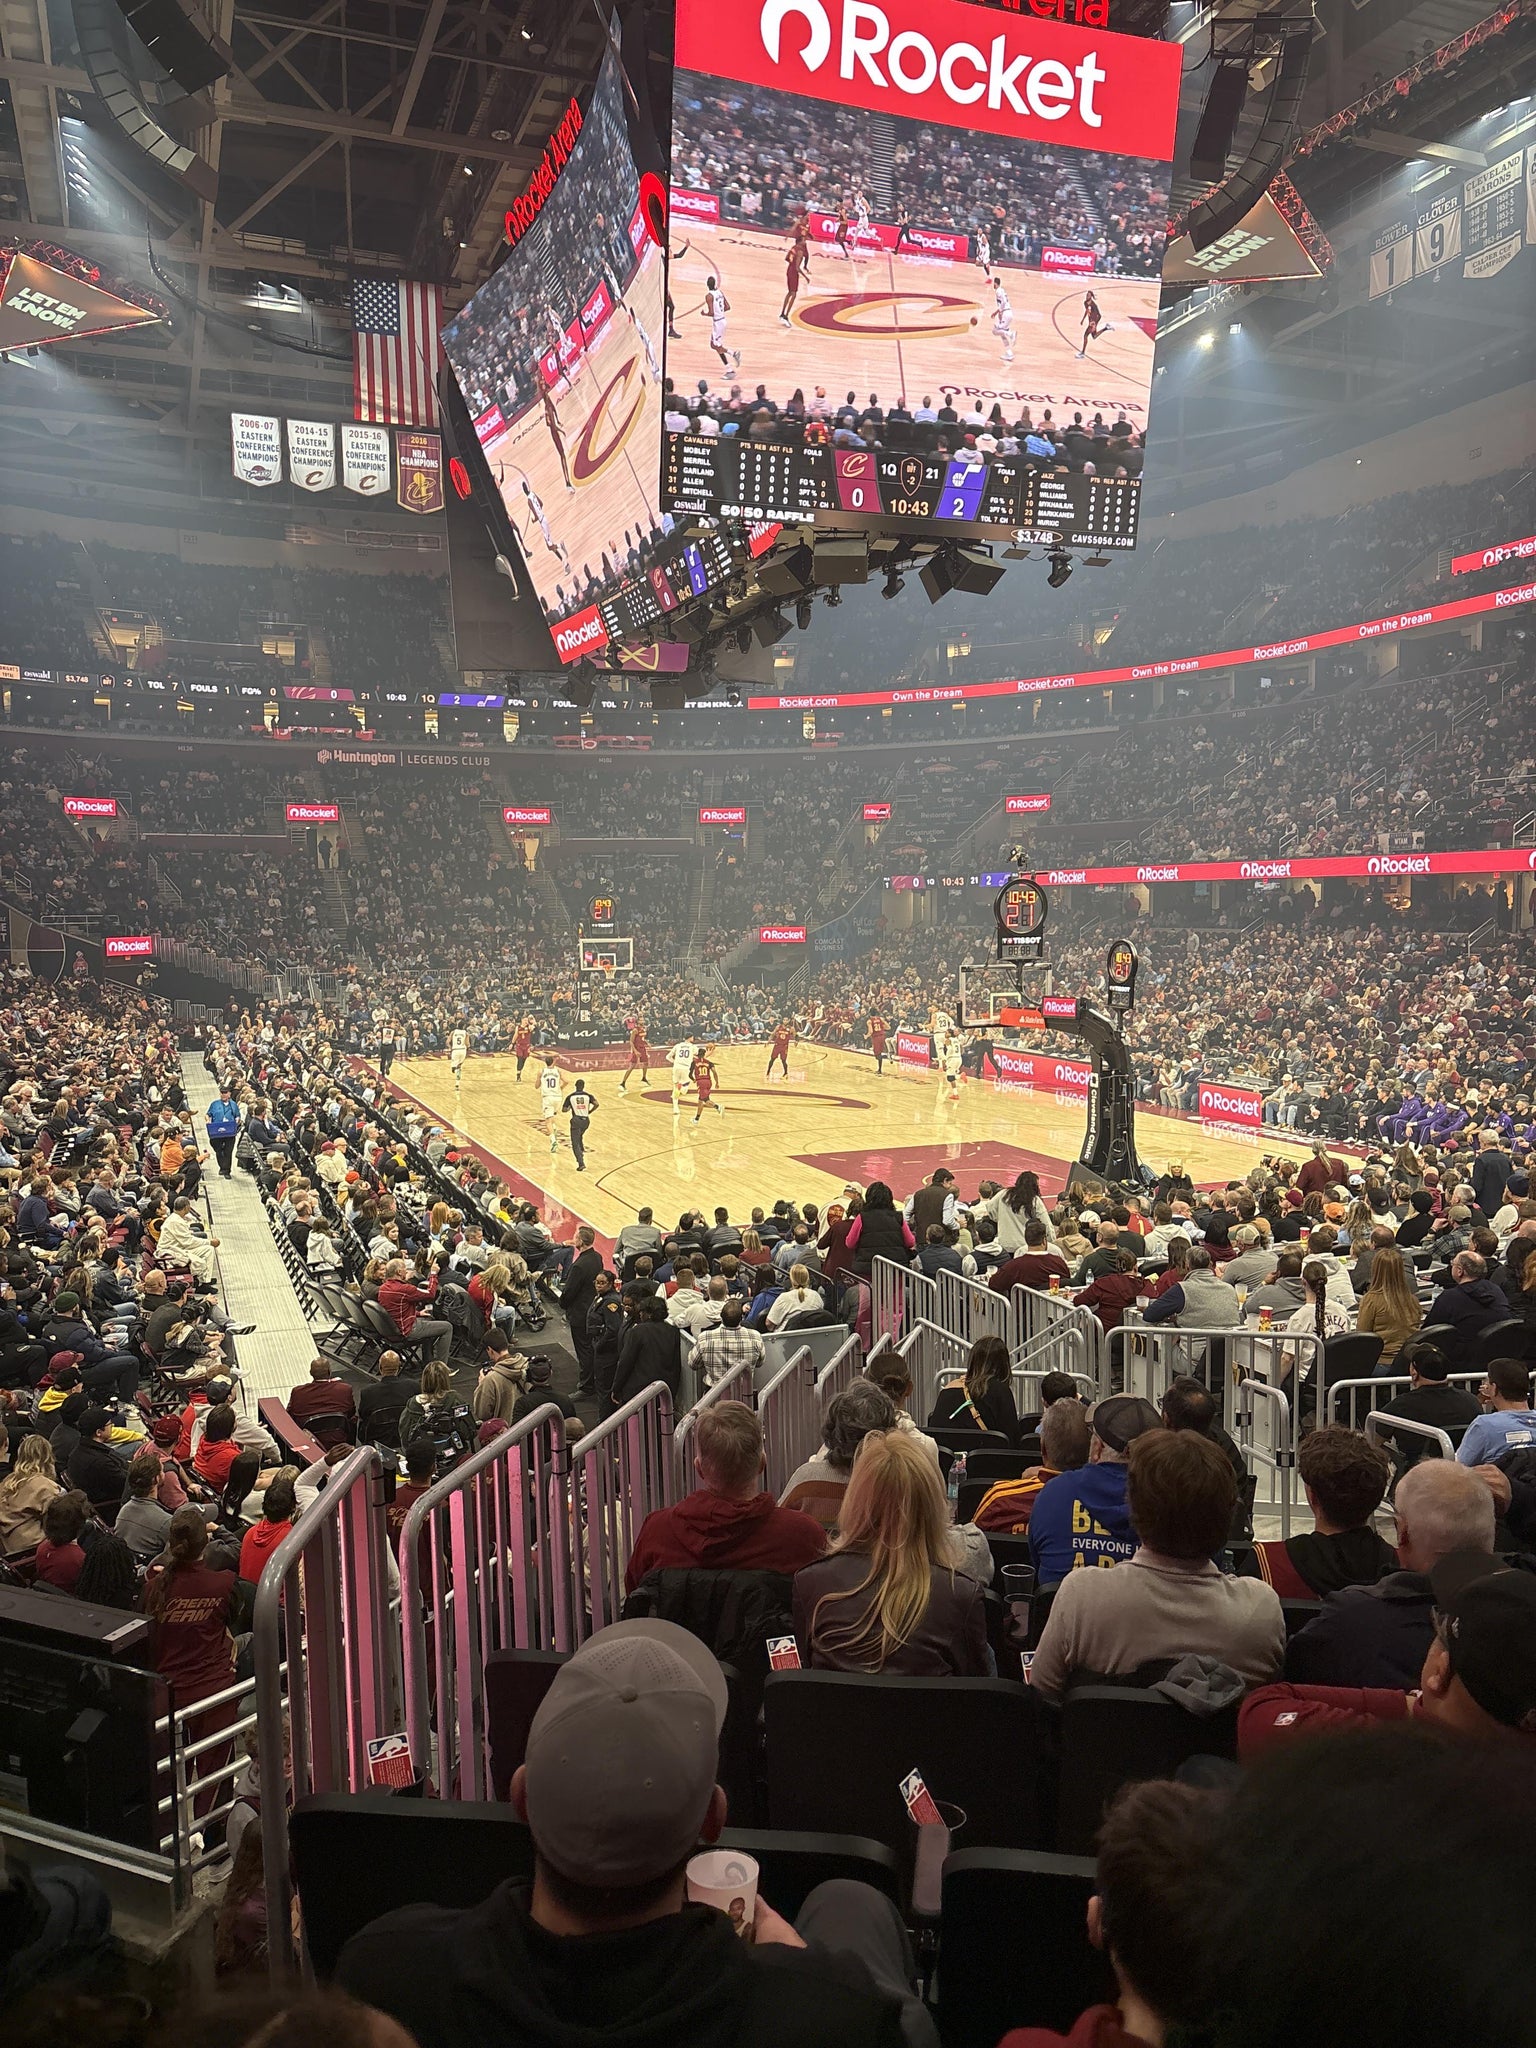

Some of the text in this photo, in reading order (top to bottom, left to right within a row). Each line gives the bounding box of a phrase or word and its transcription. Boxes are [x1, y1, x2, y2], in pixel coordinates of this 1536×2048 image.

[840, 0, 1106, 128] Rocket
[513, 97, 584, 233] Rocket Arena
[1465, 155, 1520, 192] CLEVELAND
[1474, 171, 1512, 198] BARONS
[1431, 197, 1446, 208] FRED
[1418, 197, 1458, 225] GLOVER
[1375, 225, 1408, 248] BOWER
[1185, 229, 1251, 267] LET EM
[1431, 223, 1444, 263] 9
[1055, 251, 1093, 267] Rocket
[1202, 235, 1275, 273] KNOW.
[1386, 248, 1394, 286] 1
[1472, 252, 1512, 275] CHAMPIONS
[18, 287, 87, 320] LET EM
[6, 297, 76, 330] KNOW.
[963, 386, 1145, 412] Rocket Arena
[239, 418, 274, 430] 2006-07
[241, 431, 273, 442] EASTERN
[294, 425, 329, 437] 2014-15
[348, 430, 382, 441] 2015-16
[235, 441, 280, 452] CONFERENCE
[296, 437, 327, 447] EASTERN
[350, 442, 381, 451] EASTERN
[410, 436, 428, 445] 2016
[683, 436, 718, 446] CAVALIERS
[754, 443, 767, 451] REB
[238, 451, 278, 462] CHAMPIONS
[291, 446, 334, 458] CONFERENCE
[345, 451, 387, 462] CONFERENCE
[412, 449, 427, 459] NBA
[683, 446, 711, 456] MOBLEY
[803, 448, 823, 457] FOULS
[293, 456, 332, 467] CHAMPIONS
[347, 461, 386, 471] CHAMPIONS
[400, 456, 438, 468] CHAMPIONS
[683, 456, 711, 466] MERRILL
[683, 467, 714, 476] GARLAND
[881, 463, 897, 476] 1Q
[925, 468, 939, 480] 21
[997, 468, 1016, 476] FOULS
[682, 477, 704, 486] ALLEN
[906, 477, 916, 485] -2
[1040, 472, 1055, 480] JAZZ
[682, 487, 714, 497] MITCHELL
[1039, 482, 1065, 490] GEORGE
[851, 487, 864, 507] 0
[1039, 491, 1068, 500] WILLIAMS
[674, 498, 706, 511] oswald
[798, 499, 811, 507] TOL
[890, 499, 929, 516] 10:43
[952, 498, 964, 516] 2
[766, 509, 815, 522] RAFFLE
[980, 515, 992, 523] TOL
[1037, 510, 1075, 519] MARKKANEN
[1037, 519, 1060, 527] NURKIC
[1016, 530, 1053, 544] $3,748
[1071, 534, 1134, 547] CAVS5050.COM
[695, 573, 703, 588] 2
[663, 591, 671, 606] 0
[1359, 612, 1432, 638] Own the Dream
[567, 615, 604, 648] Rocket
[1253, 640, 1308, 660] Rocket.com
[24, 670, 51, 679] oswald
[1131, 660, 1199, 678] Own the Dream
[65, 674, 89, 683] $3,748
[123, 679, 133, 687] -2
[1017, 676, 1075, 692] Rocket.com
[147, 680, 178, 691] TOL 7
[190, 684, 218, 693] FOULS
[241, 687, 276, 696] FG% 0
[330, 690, 338, 699] 0
[361, 692, 370, 700] 21
[386, 693, 407, 701] 10:43
[421, 694, 436, 703] 1Q
[454, 695, 460, 704] 2
[892, 687, 963, 701] Own the Dream
[532, 700, 538, 708] 0
[601, 700, 628, 708] TOL 7
[779, 697, 838, 707] Rocket.com
[333, 749, 490, 766] Huntington LEGENDS CLUB
[77, 800, 114, 813] Rocket
[1017, 797, 1049, 809] Rocket
[300, 807, 336, 818] Rocket
[515, 810, 548, 822] Rocket
[710, 810, 743, 821] Rocket
[1251, 861, 1291, 877] Rocket
[1381, 855, 1430, 873] Rocket
[1057, 871, 1086, 884] Rocket
[1145, 866, 1179, 881] Rocket
[913, 878, 920, 887] 0
[942, 877, 965, 886] 10:43
[970, 876, 979, 884] 21
[986, 875, 992, 885] 2
[1008, 891, 1036, 904] 10:43
[594, 906, 611, 919] 21
[1006, 904, 1035, 927] 21
[771, 929, 804, 940] Rocket
[1014, 936, 1042, 944] TISSOT
[117, 940, 150, 952] Rocket
[1115, 964, 1129, 977] 21
[1051, 1002, 1076, 1014] Rocket
[939, 1019, 946, 1027] 23
[904, 1040, 929, 1055] Rocket
[679, 1050, 690, 1058] 30
[1002, 1054, 1034, 1075] Rocket
[699, 1066, 707, 1076] 10
[547, 1078, 556, 1088] 10
[1213, 1092, 1259, 1117] Rocket
[1083, 1088, 1098, 1160] Cleveland Clinic
[1072, 1537, 1132, 1555] EVERYONE
[160, 1608, 214, 1624] TEAM
